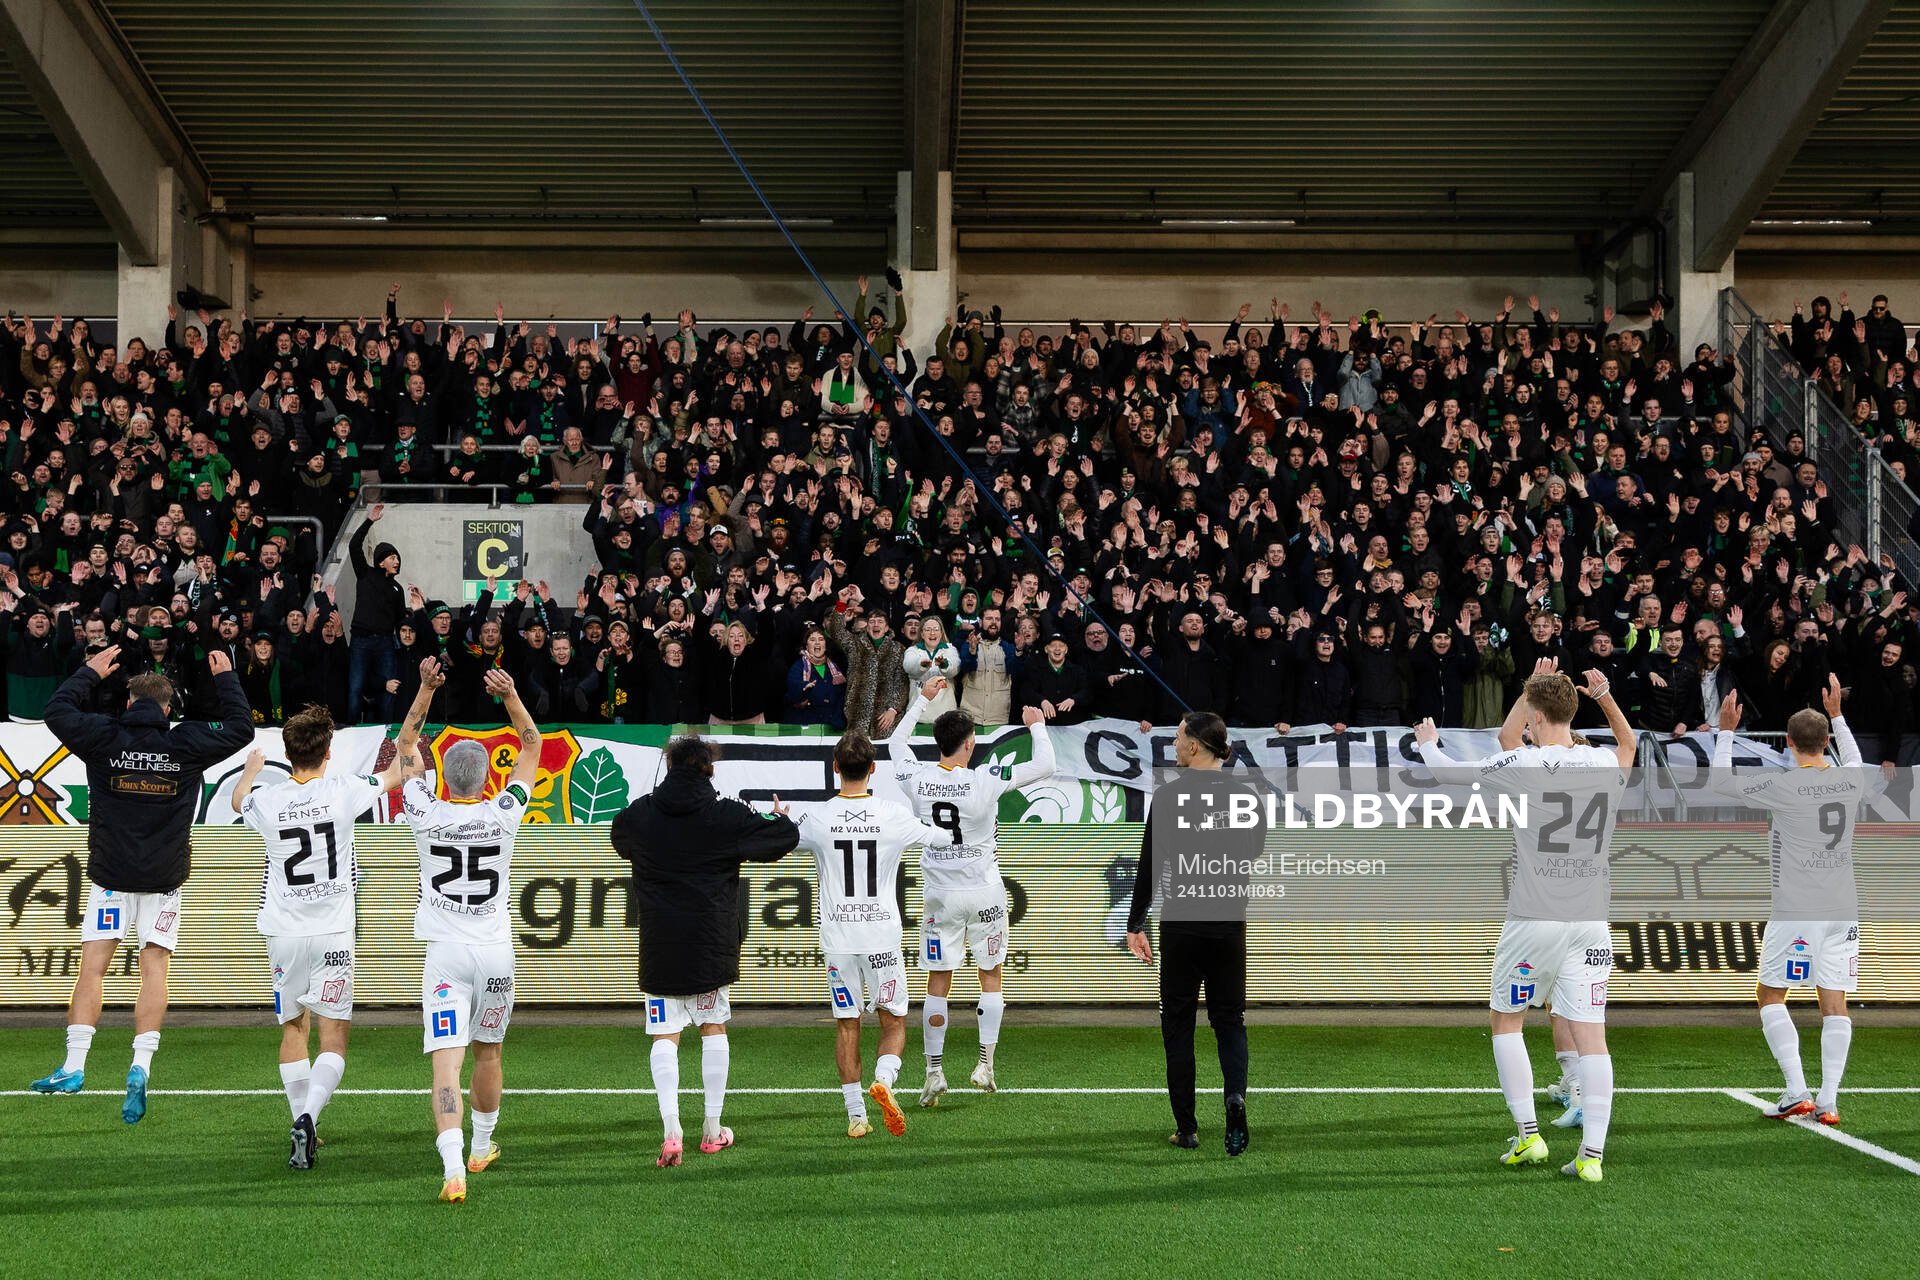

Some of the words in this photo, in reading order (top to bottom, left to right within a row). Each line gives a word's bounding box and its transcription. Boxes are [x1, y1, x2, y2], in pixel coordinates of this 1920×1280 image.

[468, 522, 519, 534] SEKTION
[477, 538, 509, 578] C
[121, 750, 170, 763] NORDIC
[109, 758, 181, 772] WELLNESS
[278, 805, 331, 822] ERNST
[931, 801, 964, 845] 9
[1537, 792, 1609, 855] 24
[1818, 801, 1847, 851] 9
[490, 828, 501, 837] AB
[278, 821, 338, 886] 21
[833, 840, 878, 897] 11
[1546, 857, 1593, 868] NORDIC
[429, 845, 501, 906] 25
[429, 895, 497, 916] WELLNESS
[836, 903, 880, 913] NORDIC
[827, 912, 891, 923] WELLNESS
[868, 951, 893, 962] GOOD
[1585, 948, 1610, 958] GOOD
[871, 957, 898, 970] ADVICE
